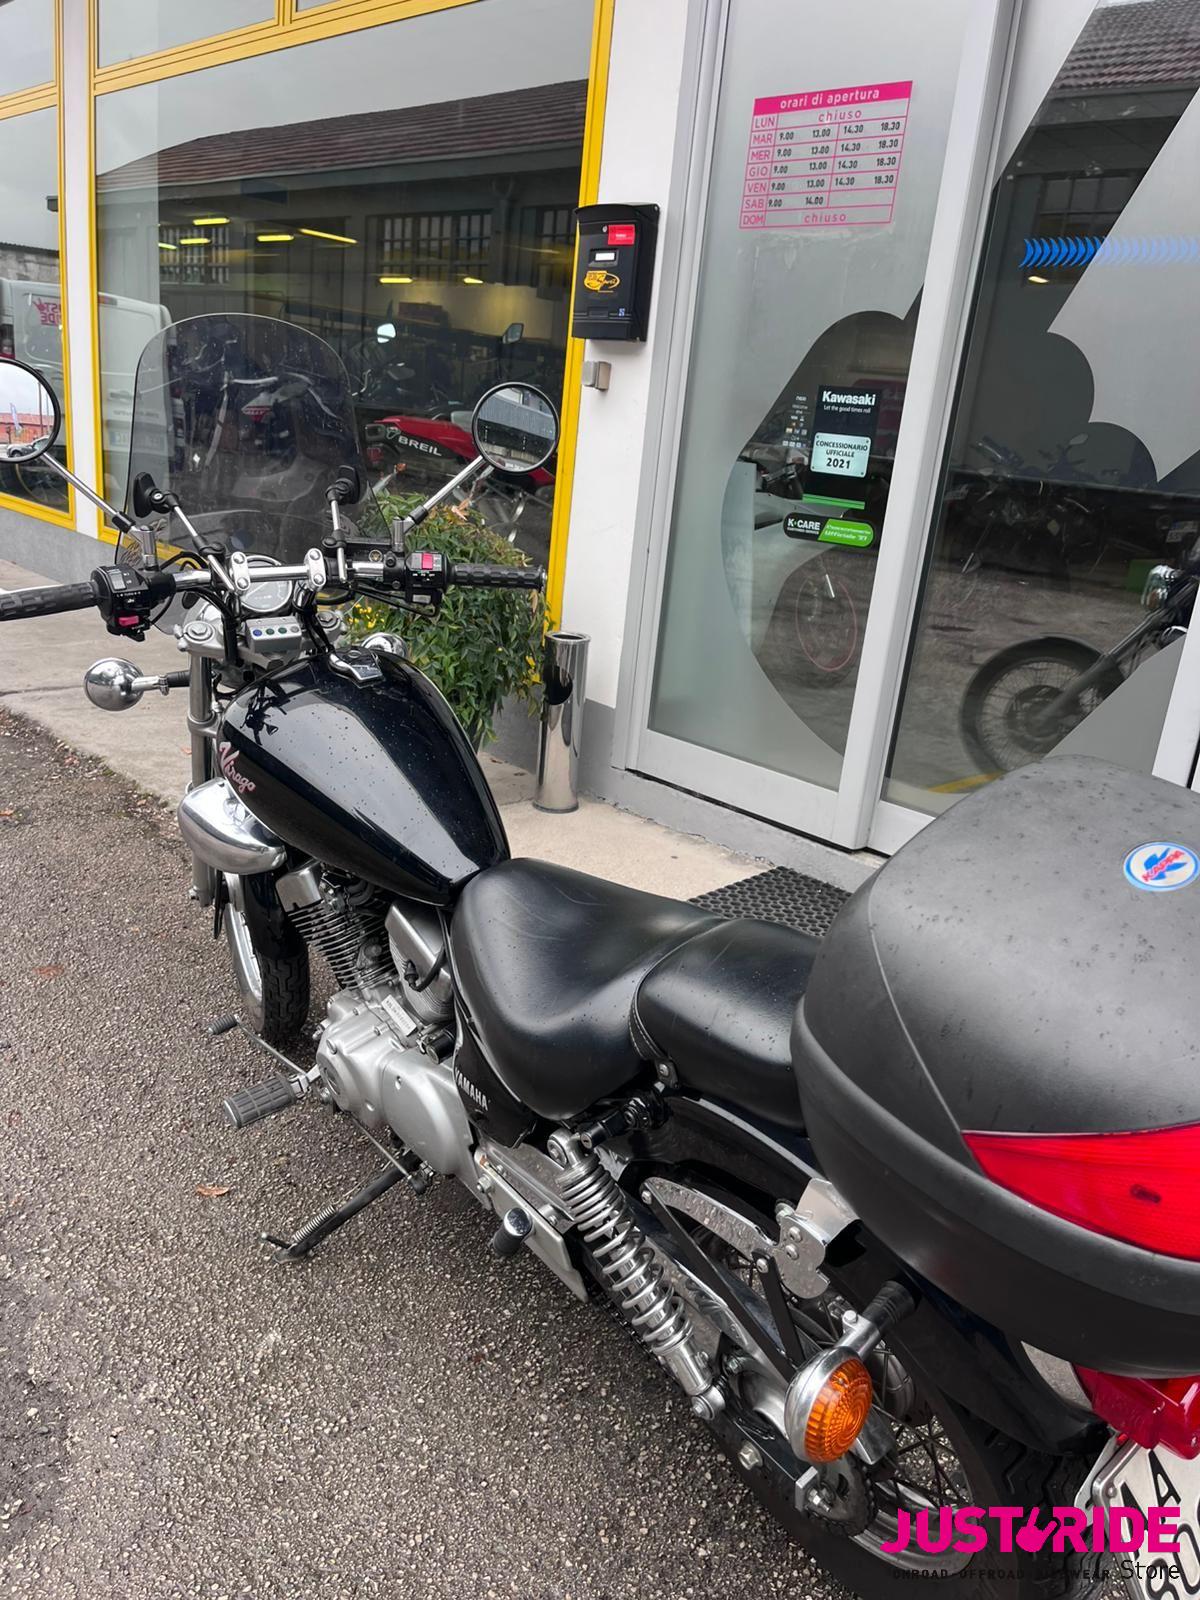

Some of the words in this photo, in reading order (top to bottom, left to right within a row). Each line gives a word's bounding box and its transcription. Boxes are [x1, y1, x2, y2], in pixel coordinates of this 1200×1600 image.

[780, 95, 808, 109] orari
[811, 93, 823, 106] di
[827, 88, 880, 105] apertura
[755, 118, 775, 128] LUN
[818, 109, 862, 123] chiuso
[753, 133, 773, 145] MAR
[779, 132, 794, 140] 9.00
[812, 128, 830, 138] 13.00
[843, 124, 864, 134] 14.30
[880, 121, 900, 131] 18.30
[751, 150, 771, 160] MER
[777, 149, 792, 157] 9.00
[811, 146, 829, 155] 13.00
[841, 143, 861, 152] 14.30
[878, 139, 898, 149] 18.30
[749, 166, 768, 177] GIO
[773, 165, 788, 174] 9.00
[809, 162, 827, 171] 13.00
[838, 160, 858, 169] 14.30
[876, 157, 896, 166] 18.30
[747, 183, 767, 193] VEN
[771, 182, 785, 191] 9.00
[807, 179, 825, 188] 13.00
[835, 177, 855, 186] 14.30
[874, 175, 894, 184] 18.30
[745, 199, 764, 209] SAB
[768, 199, 782, 208] 9.00
[805, 196, 824, 205] 14.00
[743, 215, 764, 225] DOM
[804, 213, 846, 223] chiuso
[822, 390, 876, 406] Kawasaki
[398, 435, 442, 457] BREIL
[815, 440, 868, 452] CONCESSIONARIO
[826, 449, 855, 458] UFFICIALE
[826, 458, 851, 469] 2021
[219, 741, 256, 793] Virago
[455, 1066, 488, 1111] YAMAHA
